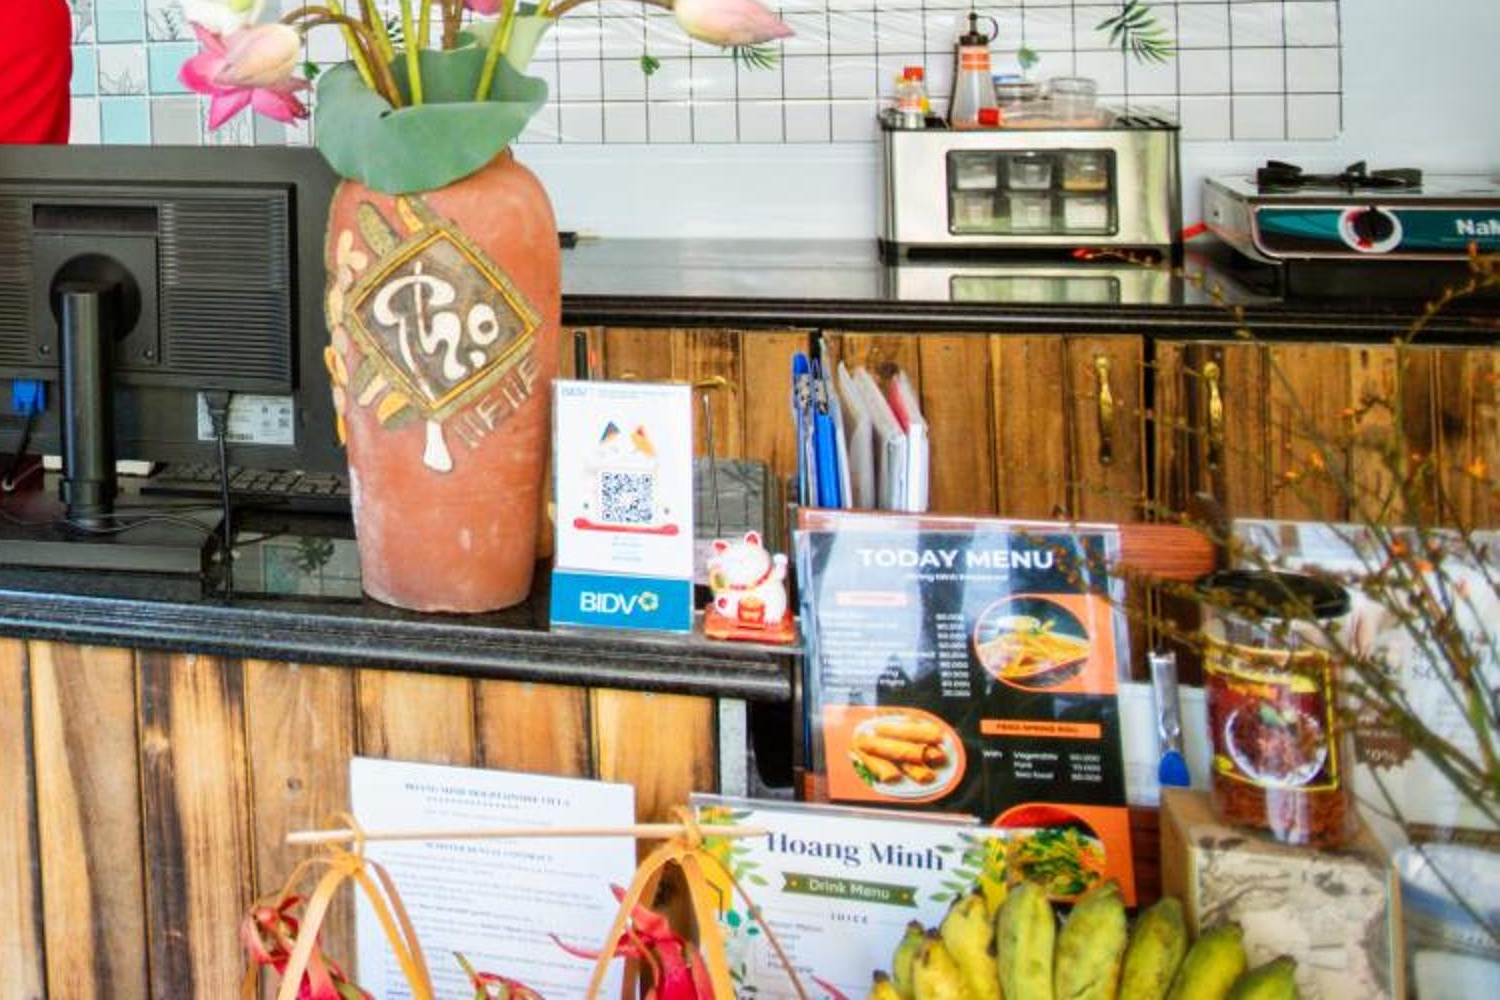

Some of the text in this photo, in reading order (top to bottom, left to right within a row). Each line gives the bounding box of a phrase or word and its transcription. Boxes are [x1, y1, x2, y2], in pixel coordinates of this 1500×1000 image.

[858, 549, 1053, 569] TODAY MENU
[580, 590, 638, 614] BIDV
[767, 831, 944, 871] Hoang Minh
[809, 876, 891, 900] Drink Menu
